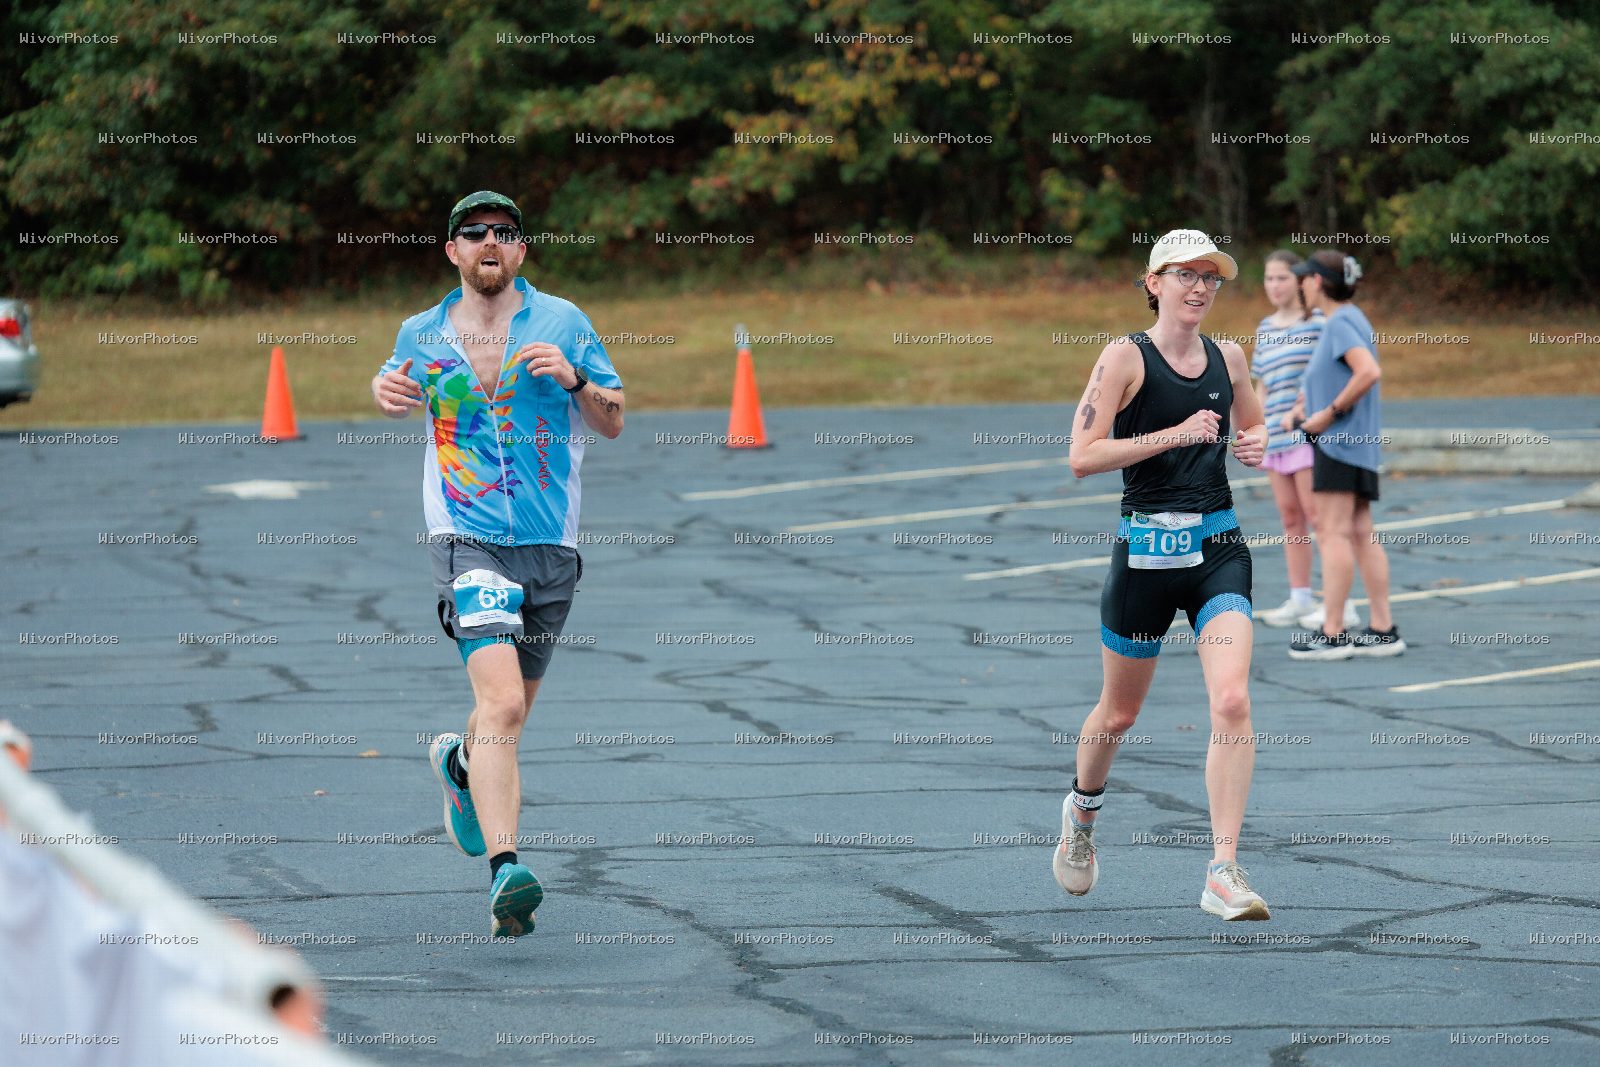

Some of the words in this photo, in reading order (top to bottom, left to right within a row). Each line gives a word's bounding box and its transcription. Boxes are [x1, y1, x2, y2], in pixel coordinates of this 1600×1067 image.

[535, 415, 551, 491] ALBANIA
[1147, 530, 1192, 555] 109
[479, 587, 509, 609] 68
